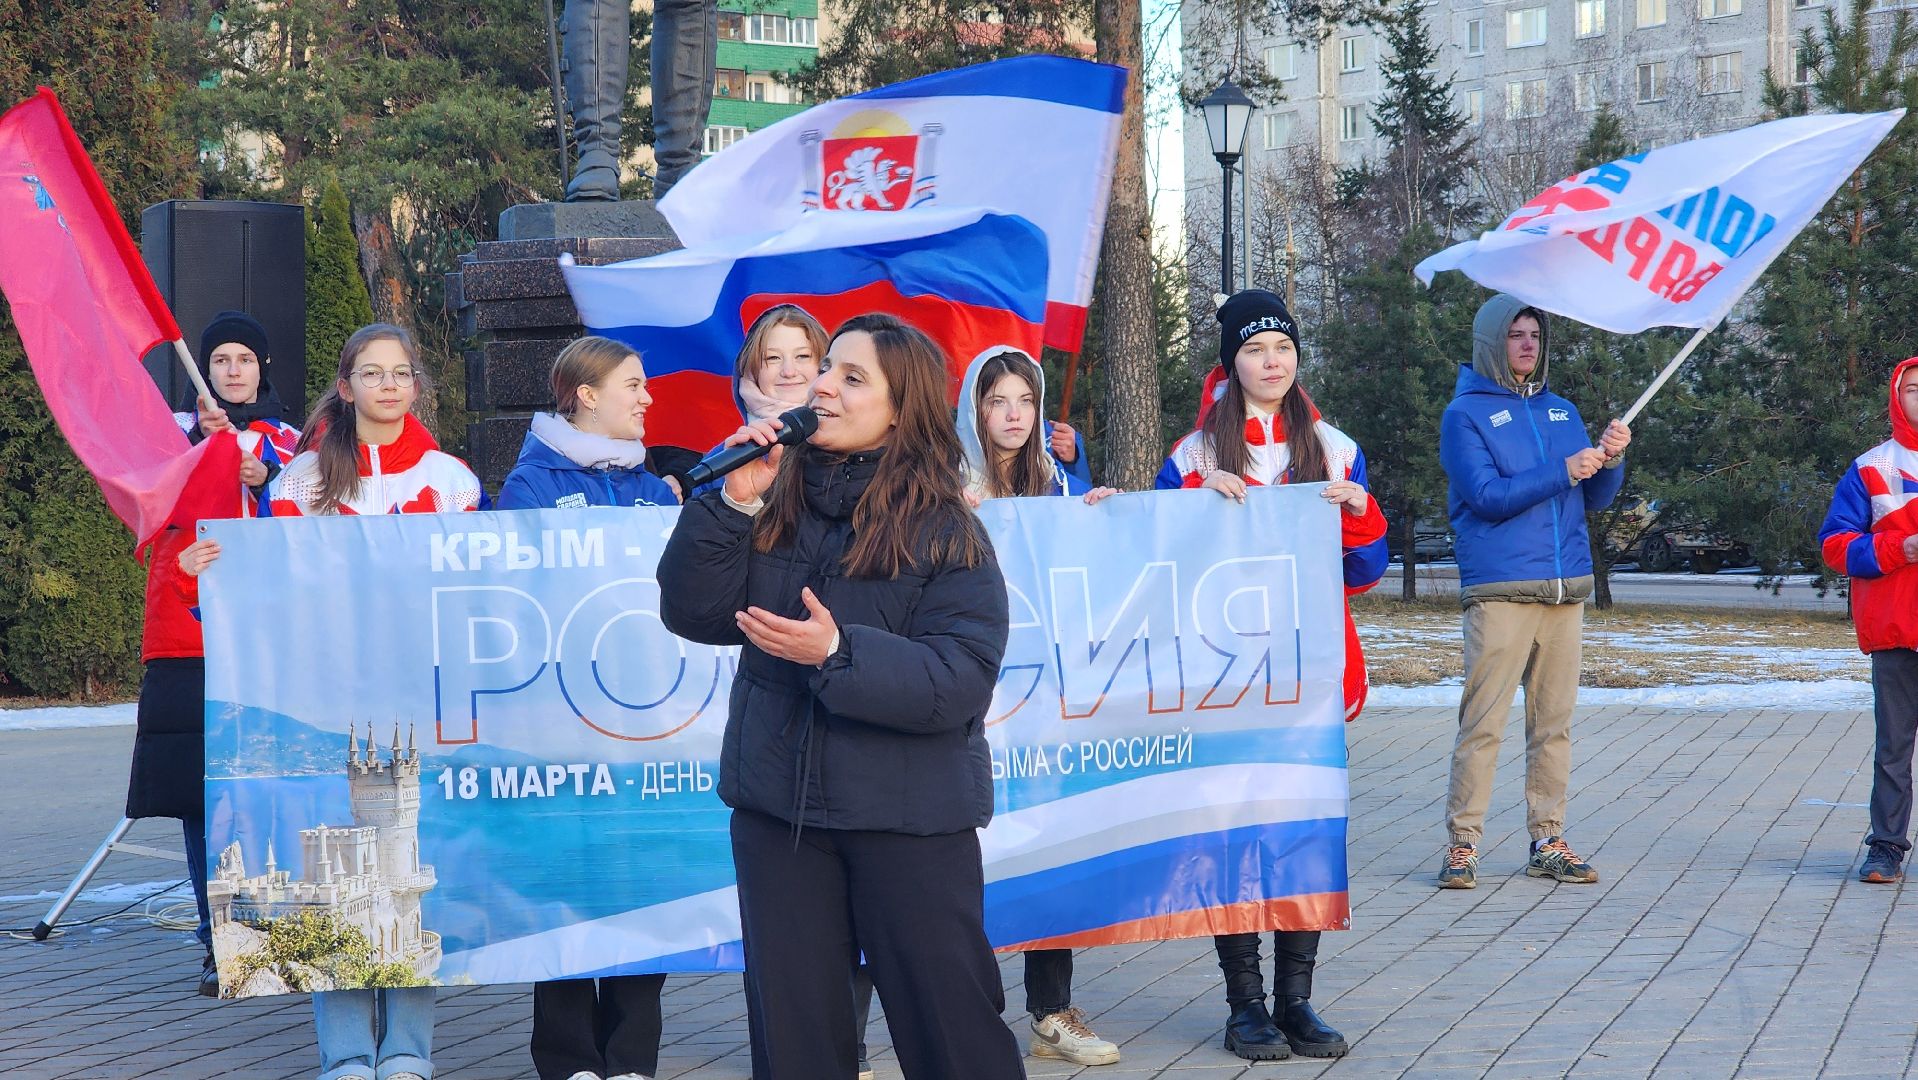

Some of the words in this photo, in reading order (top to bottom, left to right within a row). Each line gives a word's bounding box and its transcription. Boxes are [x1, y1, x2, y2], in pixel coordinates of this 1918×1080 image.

[430, 528, 605, 572] КРЫМ
[438, 767, 479, 800] 18
[490, 763, 616, 799] МАРТА
[641, 760, 714, 801] ДЕНЬ
[990, 745, 1051, 780] ЫМА
[1057, 743, 1074, 775] С
[1080, 726, 1194, 773] РОССИЕЙ
